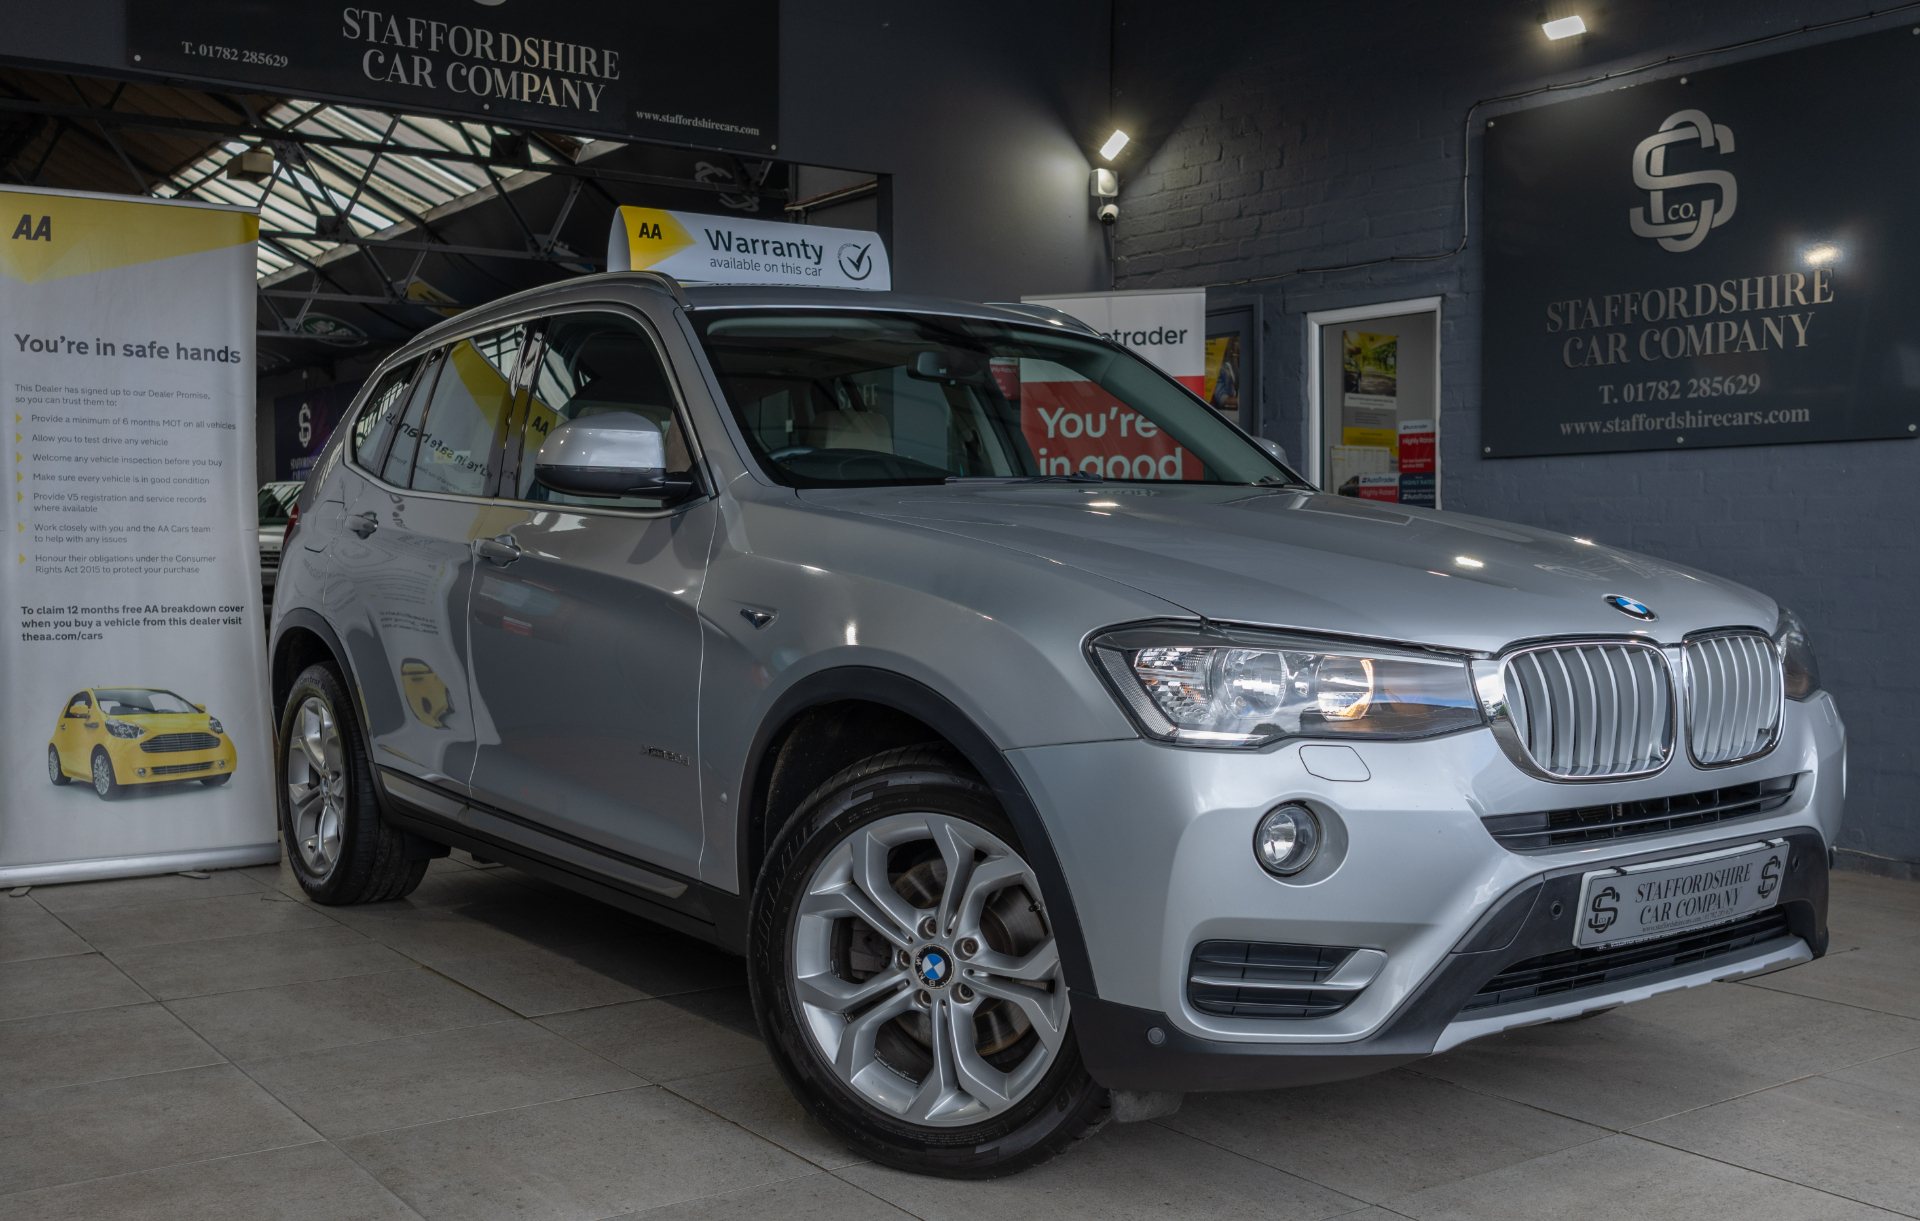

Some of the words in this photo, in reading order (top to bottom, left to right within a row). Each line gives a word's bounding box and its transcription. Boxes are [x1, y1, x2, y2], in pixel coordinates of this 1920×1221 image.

[343, 7, 620, 80] STAFFORDSHIRE
[182, 41, 196, 55] T.
[199, 44, 238, 61] 01782
[242, 50, 288, 68] 285629
[363, 49, 436, 89] CAR
[446, 62, 606, 112] COMPANY
[636, 110, 760, 136] www.staffordshirecars.com
[12, 214, 51, 241] AA
[639, 223, 662, 239] AA
[704, 229, 823, 264] Warranty
[710, 257, 760, 272] available
[764, 261, 778, 272] on
[781, 263, 802, 275] this
[805, 266, 822, 277] car
[1546, 268, 1835, 333] STAFFORDSHIRE
[14, 334, 89, 354] You're
[96, 338, 115, 356] in
[123, 341, 169, 359] safe
[176, 343, 241, 363] hands
[1563, 332, 1630, 369] CAR
[1639, 312, 1815, 362] COMPANY
[15, 384, 32, 392] This
[35, 385, 62, 393] Dealer
[65, 386, 78, 394] has
[81, 387, 108, 396] signed
[148, 390, 174, 398] Dealer
[176, 391, 210, 400] Promise,
[1599, 385, 1617, 405] T.
[1623, 380, 1680, 402] 01782
[1687, 374, 1760, 398] 285629
[28, 397, 43, 405] you
[84, 398, 104, 406] them
[106, 399, 117, 407] to:
[32, 414, 63, 423] Provide
[73, 416, 110, 425] minimum
[123, 417, 128, 425] 6
[131, 418, 160, 426] months
[163, 419, 181, 427] MOT
[207, 422, 236, 430] vehicles
[1037, 407, 1158, 438] You're
[1560, 408, 1810, 435] www.staffordshirecars.com
[32, 434, 55, 442] Allow
[58, 436, 72, 444] you
[102, 437, 122, 445] drive
[141, 438, 168, 446] vehicle
[33, 454, 72, 462] Welcome
[74, 456, 88, 464] any
[90, 455, 119, 464] vehicle
[122, 456, 162, 465] inspection
[164, 457, 190, 466] before
[192, 459, 206, 467] you
[208, 459, 222, 467] buy
[1039, 448, 1071, 476] in
[33, 473, 56, 481] Make
[78, 475, 99, 483] every
[102, 474, 130, 483] vehicle
[151, 476, 170, 485] good
[173, 476, 209, 484] condition
[34, 493, 65, 501] Provide
[81, 494, 127, 503] registration
[129, 494, 144, 502] and
[1362, 489, 1378, 497] Highly
[1379, 488, 1395, 496] Rated
[34, 504, 60, 512] where
[62, 504, 98, 513] available
[34, 524, 57, 532] Work
[59, 524, 87, 533] closely
[89, 524, 107, 532] with
[109, 526, 124, 534] you
[126, 525, 141, 533] and
[143, 525, 156, 533] the
[171, 525, 189, 533] Cars
[35, 535, 43, 543] to
[45, 535, 63, 545] help
[66, 535, 83, 543] with
[36, 555, 66, 563] Honour
[68, 555, 87, 563] their
[89, 555, 134, 565] obligations
[136, 555, 158, 563] under
[161, 555, 173, 563] the
[176, 555, 216, 563] Consumer
[36, 566, 62, 575] Rights
[64, 566, 78, 574] Act
[80, 566, 100, 574] 2015
[103, 566, 111, 574] to
[113, 566, 142, 575] protect
[164, 566, 200, 575] purchase
[21, 606, 34, 615] To
[37, 606, 65, 614] claim
[67, 606, 78, 614] 12
[81, 606, 119, 614] months
[122, 605, 142, 614] free
[144, 605, 158, 613] AA
[161, 605, 216, 614] breakdown
[219, 605, 244, 613] cover
[22, 619, 50, 628] when
[53, 620, 72, 630] you
[74, 618, 93, 629] buy
[104, 618, 140, 627] vehicle
[143, 618, 166, 626] from
[169, 617, 187, 626] this
[190, 617, 220, 625] dealer
[223, 616, 242, 625] visit
[22, 632, 103, 642] theaa.com/cars
[1635, 862, 1753, 903] STAFFORDSHIRE
[1640, 903, 1671, 925] CAR
[1676, 886, 1743, 919] COMPANY
